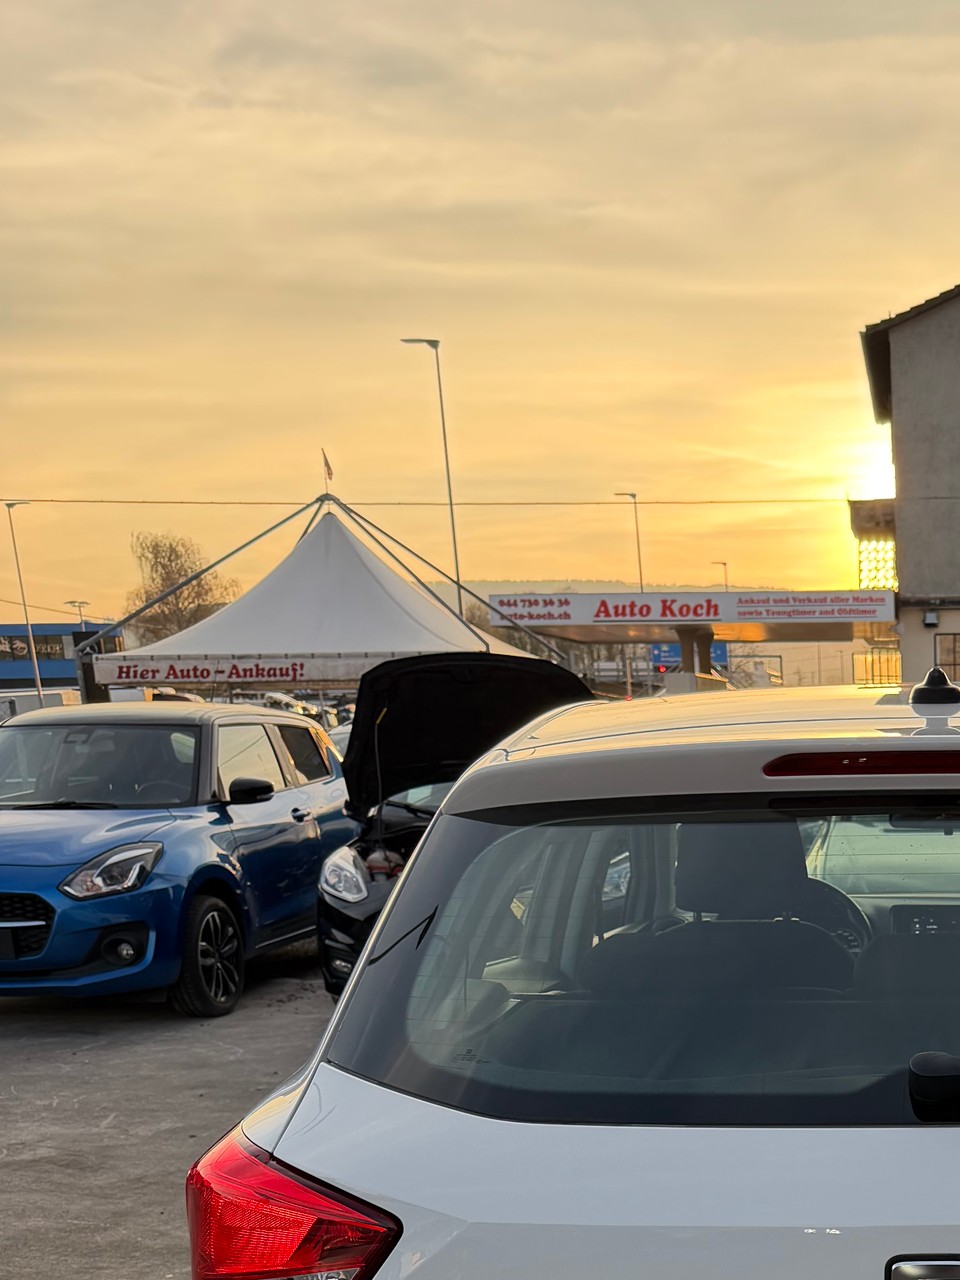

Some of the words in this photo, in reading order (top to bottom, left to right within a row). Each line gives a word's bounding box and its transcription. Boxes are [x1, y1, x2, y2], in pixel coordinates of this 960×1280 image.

[594, 600, 652, 618] Auto
[660, 599, 720, 618] Koch
[117, 664, 160, 680] Hier
